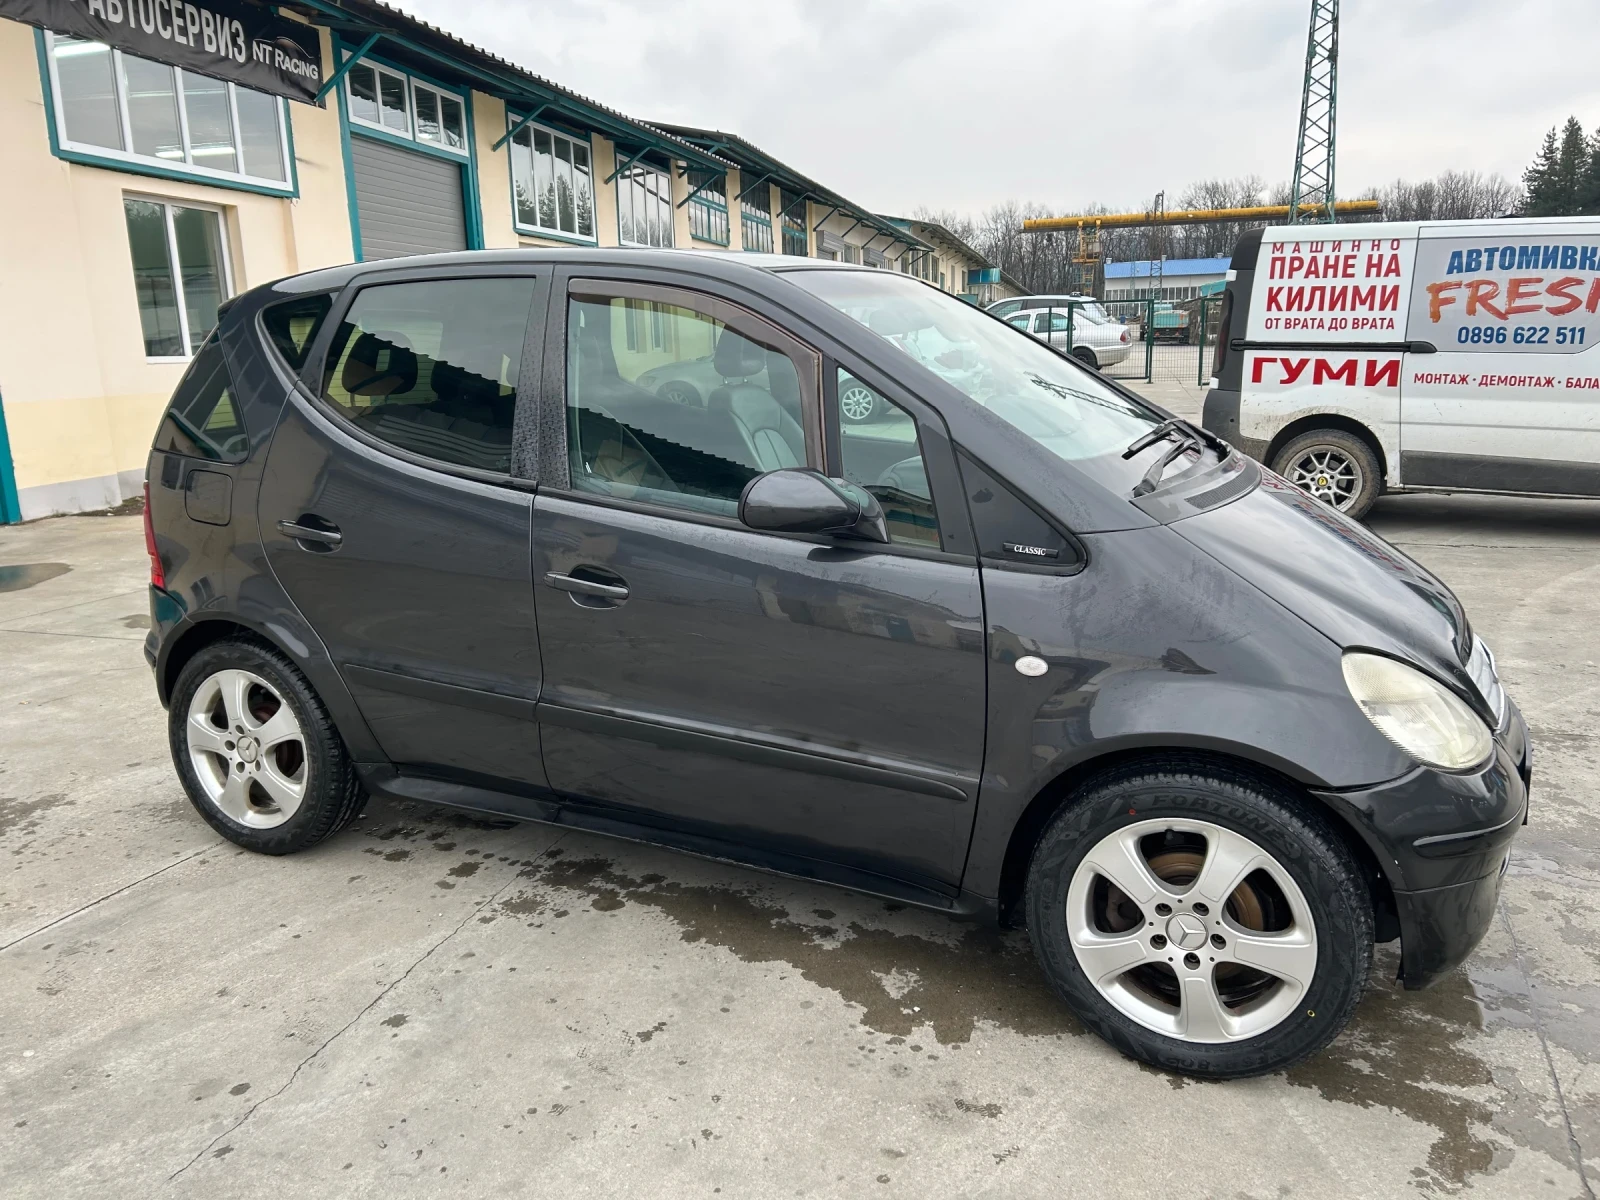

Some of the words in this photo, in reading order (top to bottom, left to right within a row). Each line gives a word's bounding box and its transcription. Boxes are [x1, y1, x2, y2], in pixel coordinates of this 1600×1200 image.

[252, 40, 273, 65] NT
[274, 48, 319, 80] RACING
[1271, 238, 1401, 254] МАШИННО
[1269, 254, 1358, 280] ПРАНЕ
[1365, 253, 1401, 278] НА
[1446, 245, 1600, 275] АВТОМИВК
[1266, 284, 1400, 312] КИЛИМИ
[1264, 317, 1281, 330] ОТ
[1284, 317, 1325, 330] ВРАТА
[1327, 317, 1348, 332] ДО
[1351, 317, 1395, 330] ВРАТА
[1457, 326, 1507, 344] 0896
[1512, 326, 1550, 344] 622
[1555, 326, 1586, 344] 511
[1251, 357, 1401, 387] ГУМИ
[1413, 373, 1470, 386] МОНТАЖ
[1478, 374, 1556, 388] ДЕМОНТАЖ
[1013, 544, 1047, 556] CLASSIC
